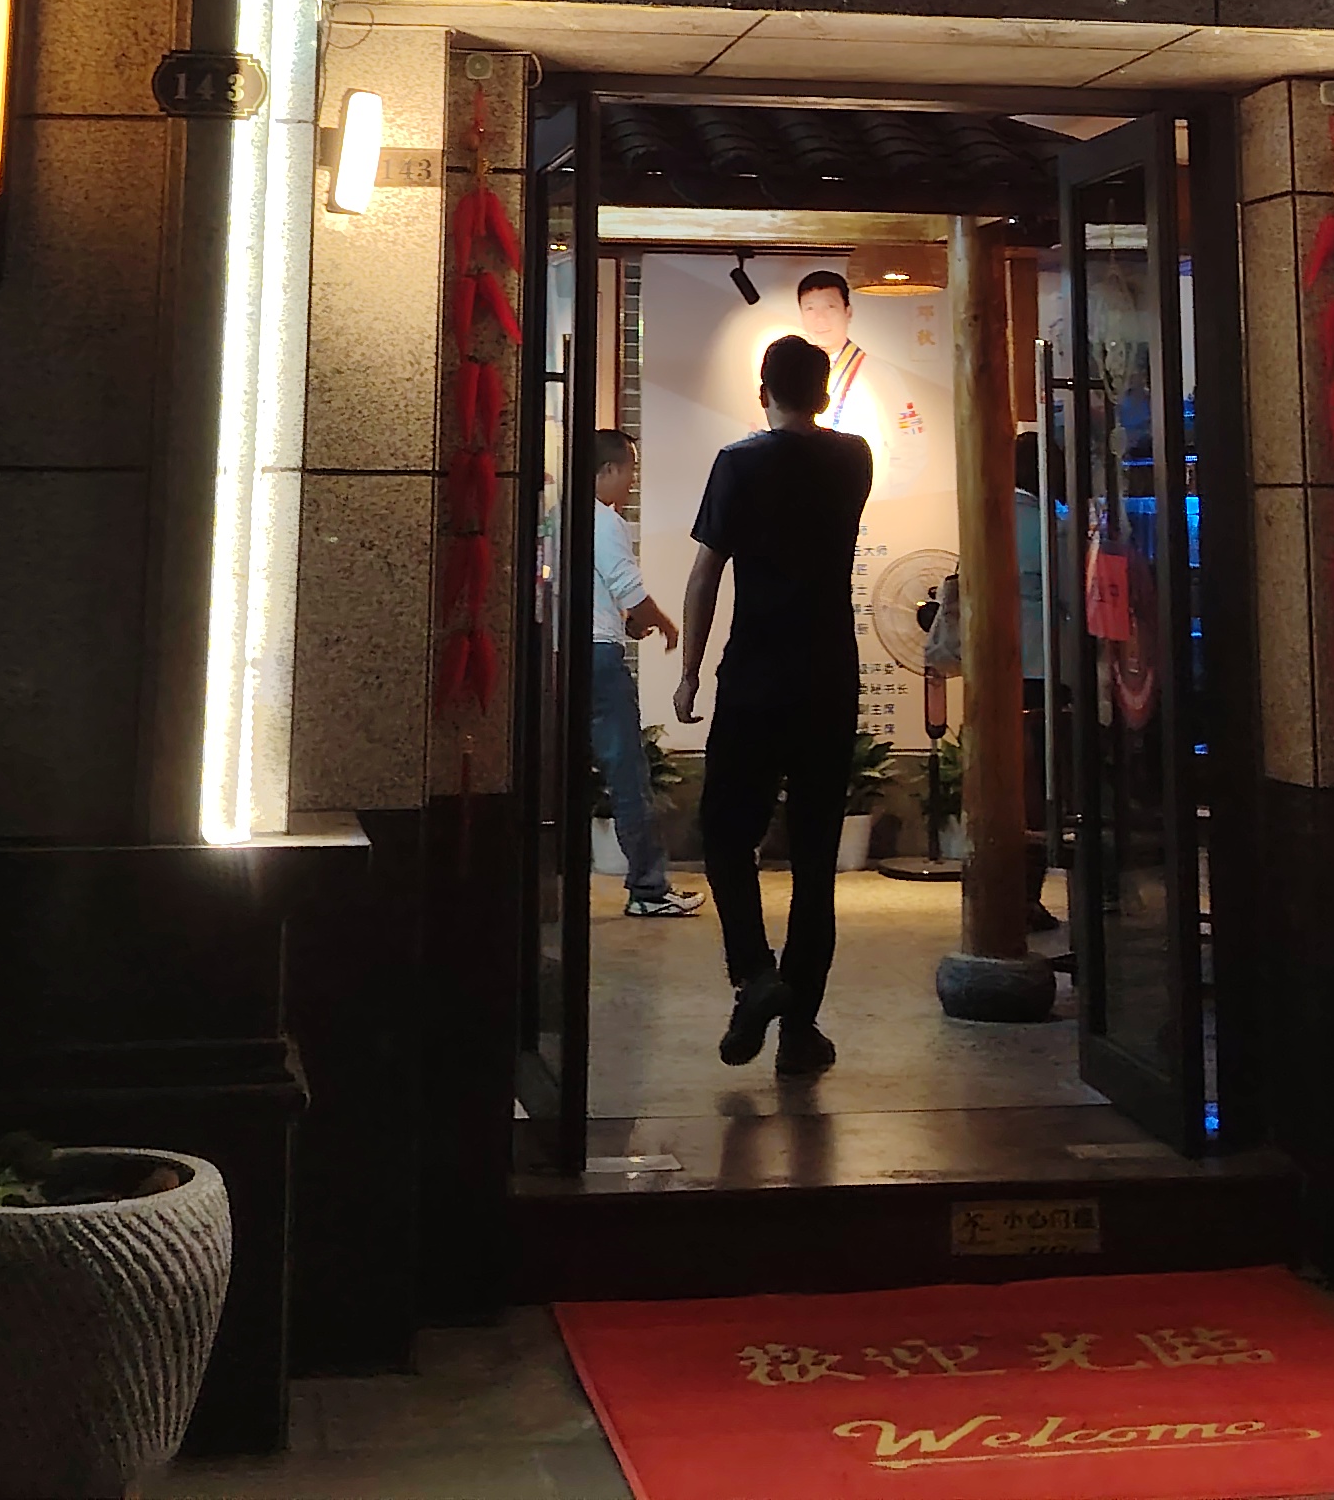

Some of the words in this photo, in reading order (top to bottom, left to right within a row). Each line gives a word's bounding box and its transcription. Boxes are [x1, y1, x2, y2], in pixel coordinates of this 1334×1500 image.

[174, 73, 246, 103] 143
[382, 157, 433, 183] 143
[832, 1414, 1322, 1470] Welcome
